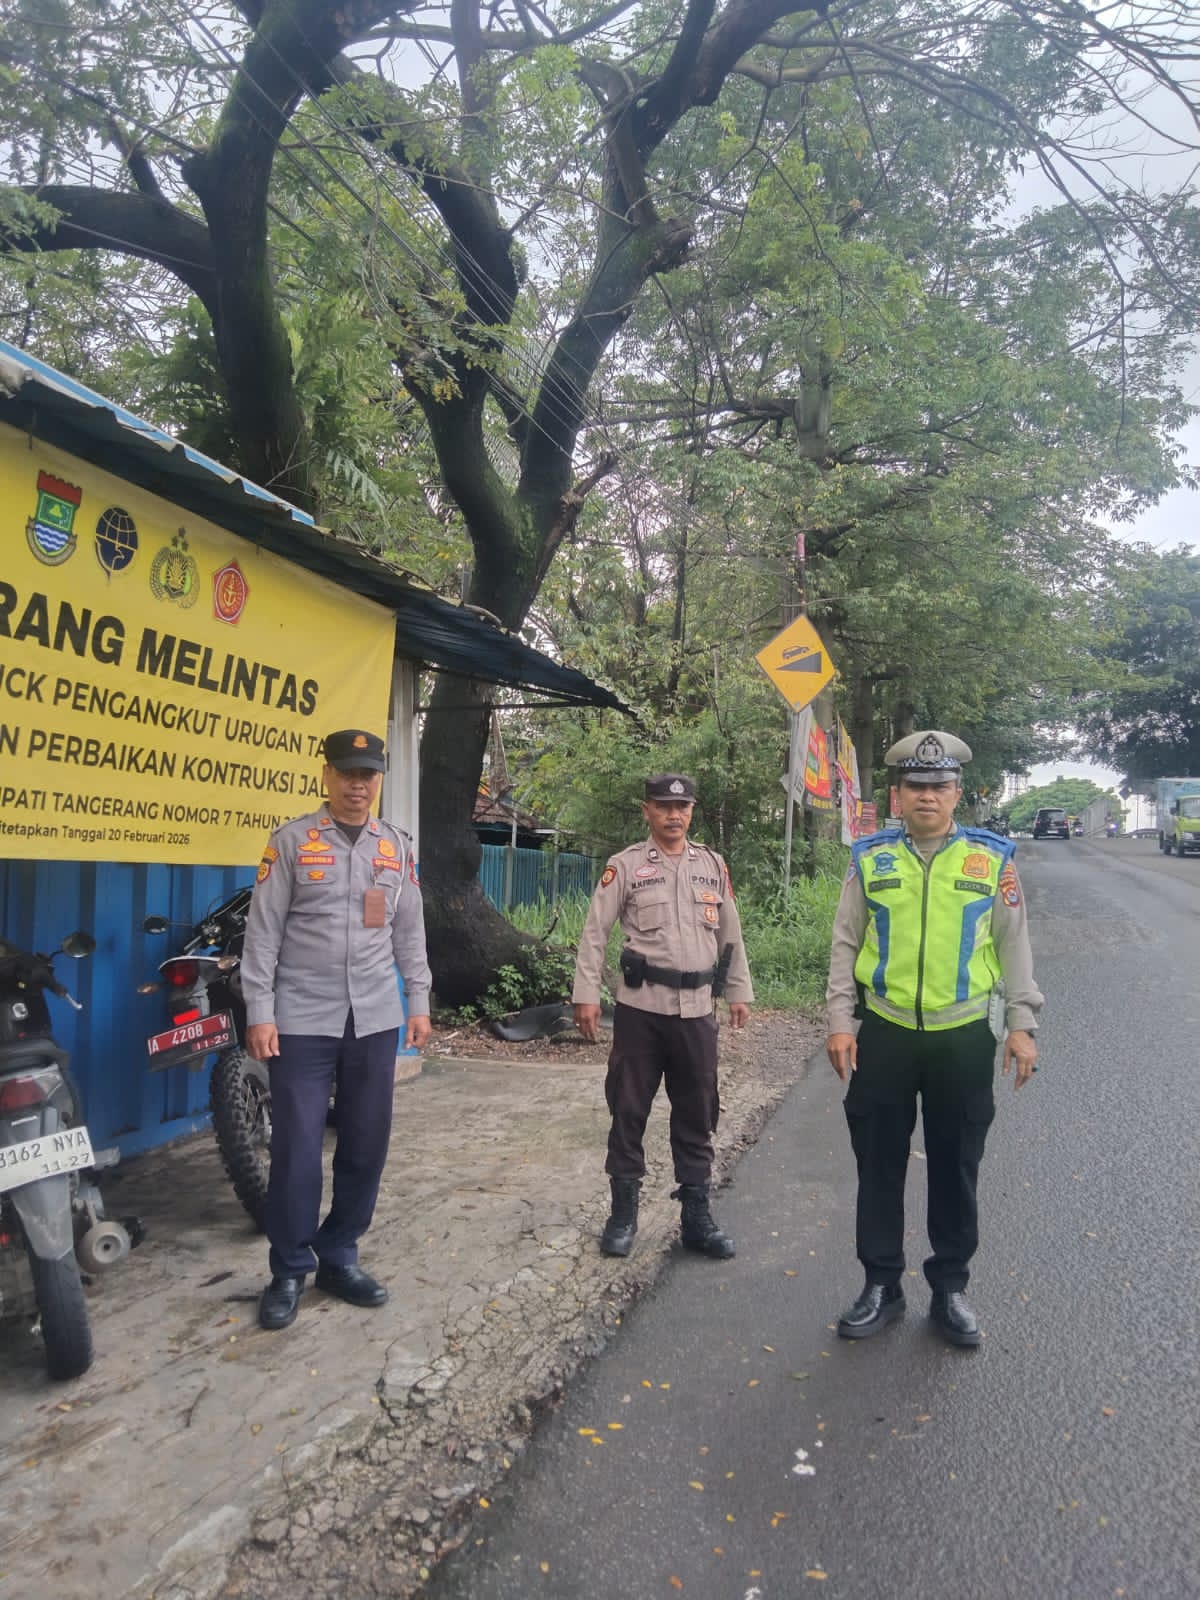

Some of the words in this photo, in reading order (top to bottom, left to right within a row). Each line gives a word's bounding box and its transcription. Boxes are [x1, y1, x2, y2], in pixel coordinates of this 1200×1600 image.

[136, 627, 319, 716] MELINTAS
[53, 677, 221, 737] PENGANGKUT
[225, 717, 302, 755] URUGAN
[27, 729, 177, 778] PERBAIKAN
[182, 755, 295, 794] KONTRUKSI
[0, 786, 47, 811] PATI
[53, 792, 159, 820] TANGERANG
[162, 803, 220, 825] NOMOR
[223, 810, 232, 826] 7
[236, 811, 281, 830] TAHUN
[62, 825, 106, 843] Tanggal
[108, 828, 121, 841] 20
[124, 830, 165, 844] Februari
[167, 832, 190, 845] 2026
[691, 875, 718, 888] POLRI
[53, 1131, 87, 1152] NYA
